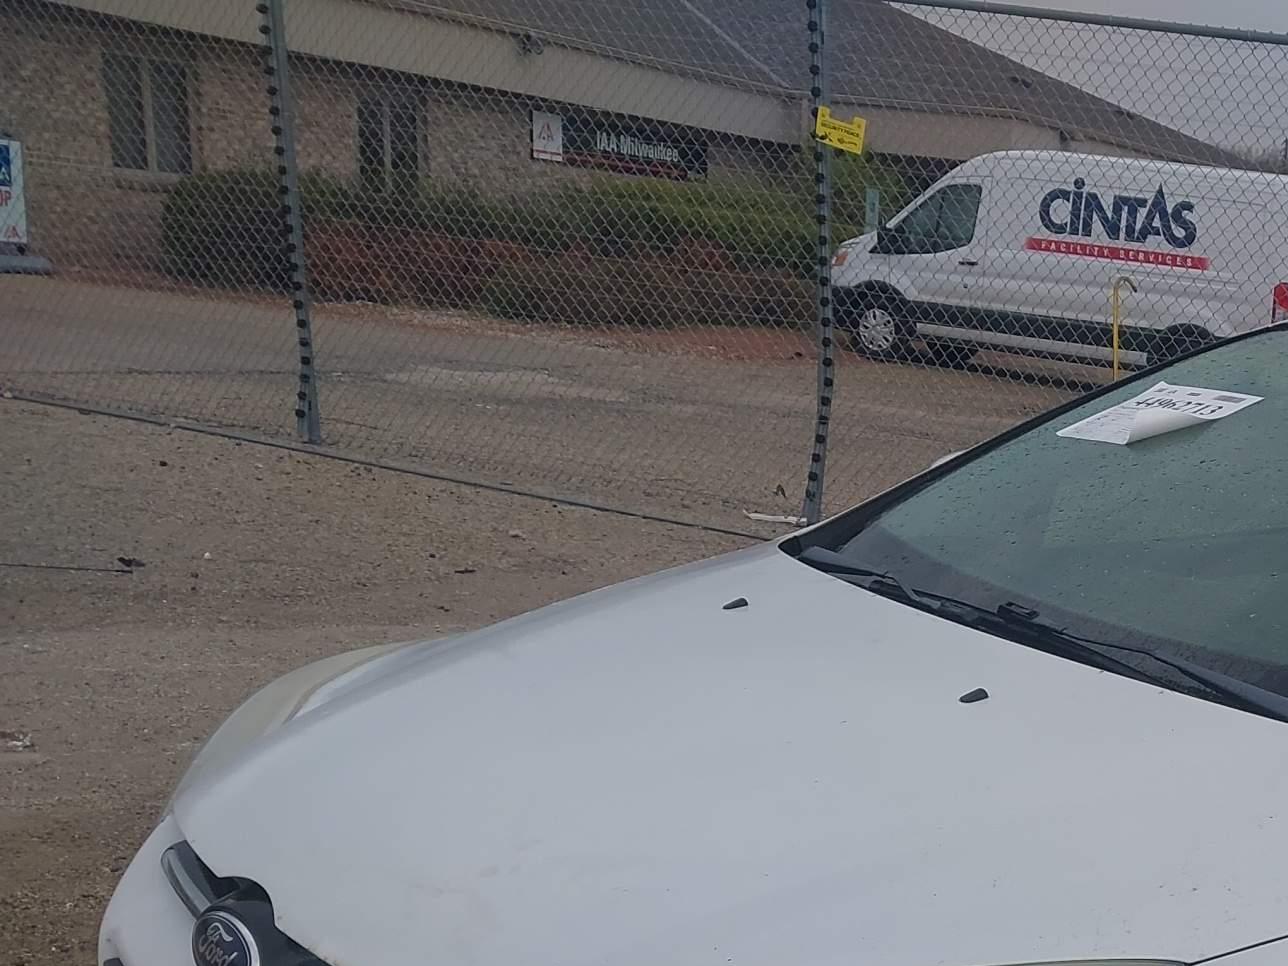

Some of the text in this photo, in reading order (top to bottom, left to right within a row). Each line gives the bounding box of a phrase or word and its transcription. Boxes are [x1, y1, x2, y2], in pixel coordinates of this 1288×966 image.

[596, 131, 679, 161] IAA Milwaukee
[1041, 240, 1193, 267] FACILITY SERVICES
